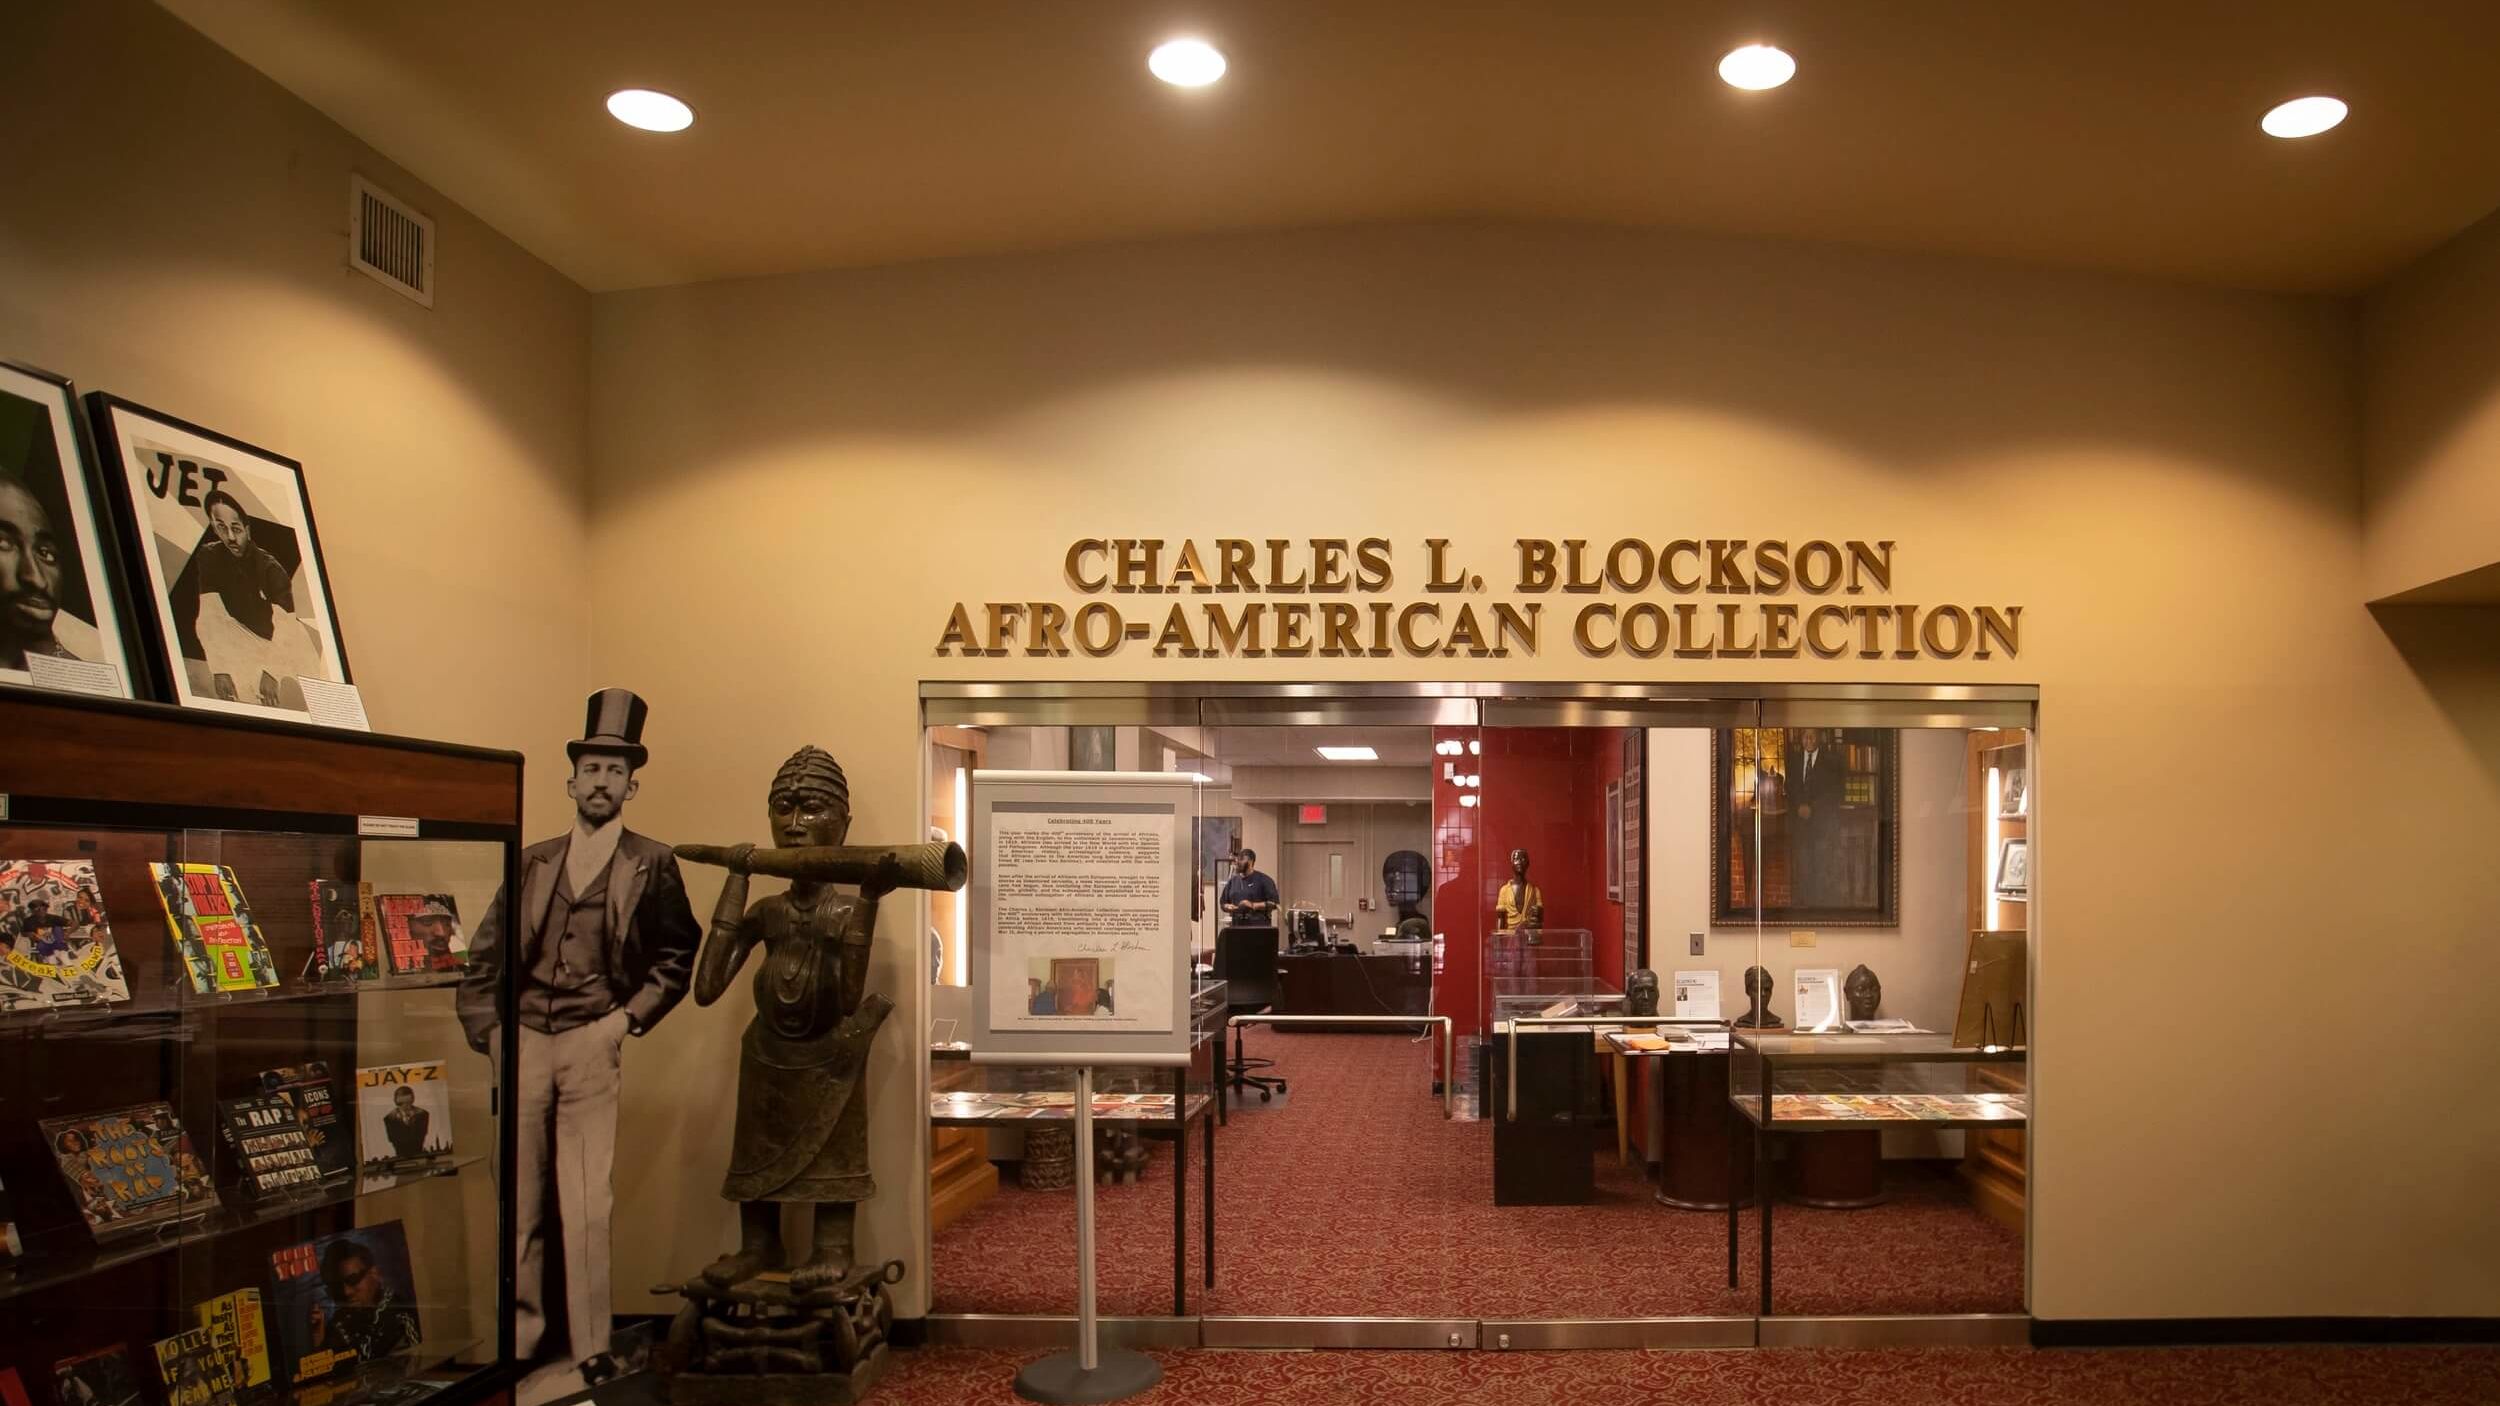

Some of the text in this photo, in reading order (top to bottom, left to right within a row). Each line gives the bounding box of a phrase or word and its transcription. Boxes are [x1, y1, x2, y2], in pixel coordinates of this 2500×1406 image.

[147, 452, 228, 507] JET
[1065, 537, 1897, 594] CHARLES L. BLOCKSON
[934, 601, 2023, 660] AFRO-AMERICAN COLLECTION
[12, 952, 55, 977] Break
[81, 946, 103, 971] Down
[365, 1066, 438, 1088] JAY-Z
[303, 1089, 330, 1104] ICONS
[89, 1118, 136, 1141] THE
[248, 1108, 283, 1127] RAP
[88, 1136, 166, 1168] ROOTS
[111, 1174, 164, 1201] RAP
